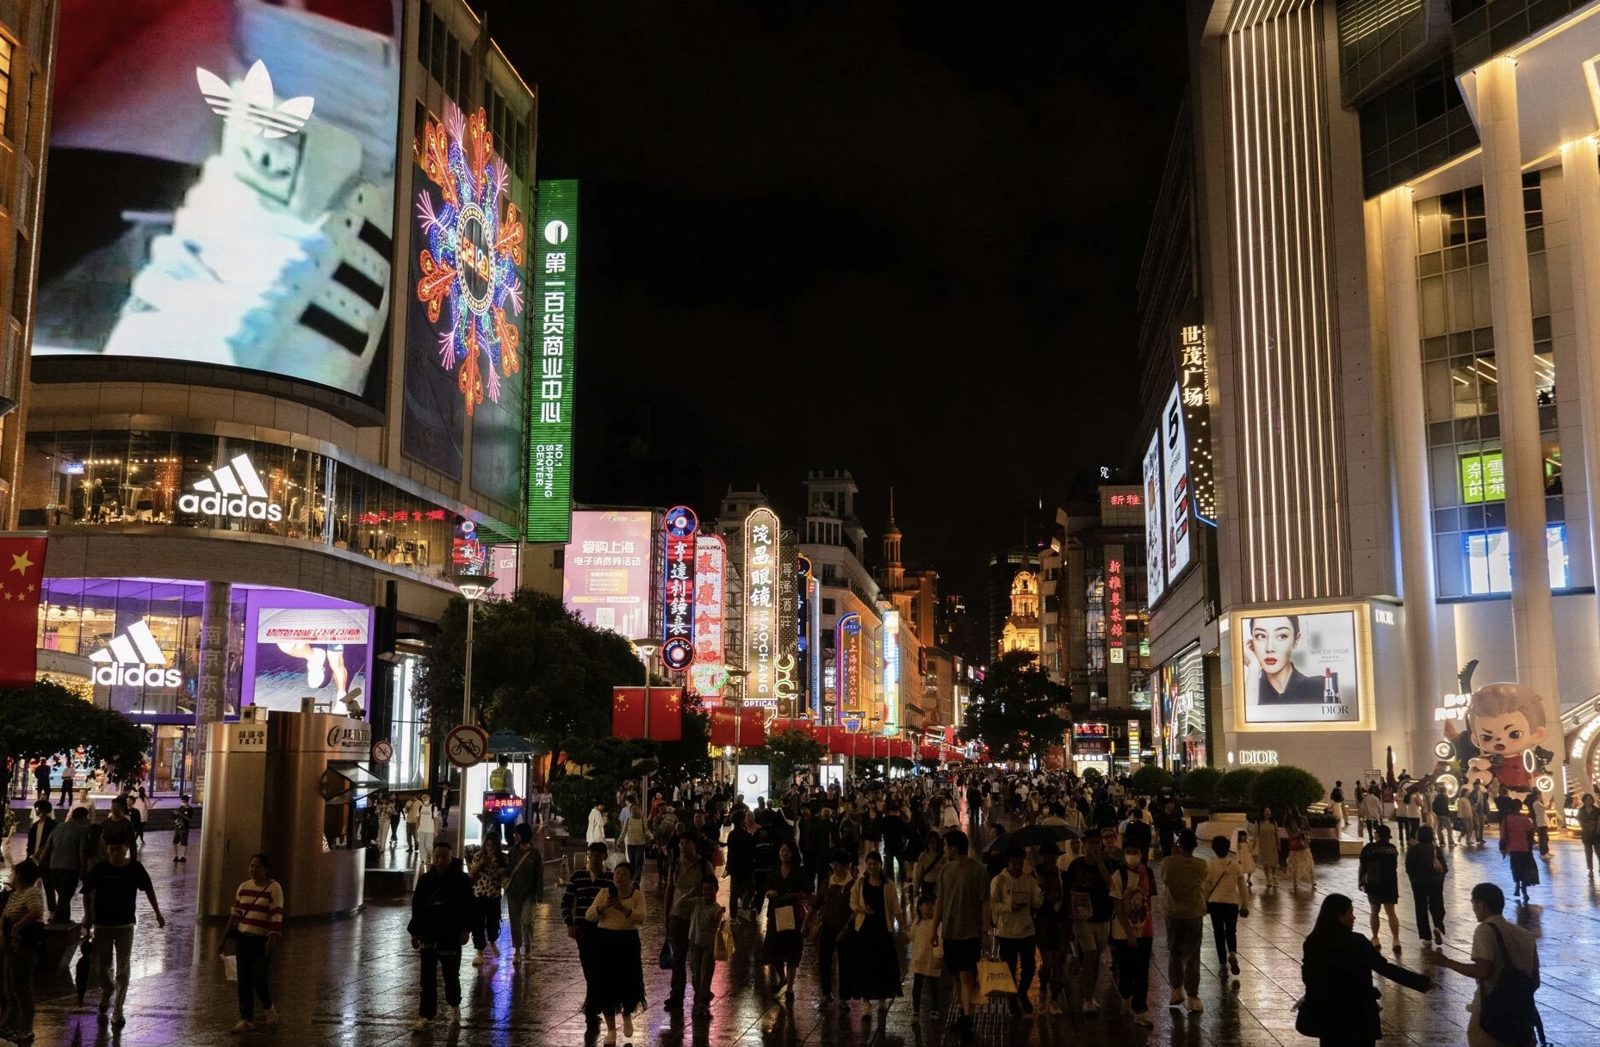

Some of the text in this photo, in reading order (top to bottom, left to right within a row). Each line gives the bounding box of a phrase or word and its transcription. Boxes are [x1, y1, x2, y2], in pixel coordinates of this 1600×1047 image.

[540, 252, 566, 422] 第一百货商业中心
[1180, 325, 1203, 406] 世茂广场
[535, 444, 545, 487] CENTER
[544, 444, 554, 498] SHOPPING
[555, 443, 563, 467] NO.1
[178, 491, 283, 522] adidas
[1110, 494, 1141, 506] 新雅
[582, 540, 634, 553] 爱购上海
[750, 524, 772, 607] 茂昌眼镜
[1109, 560, 1123, 637] 新雅粤菜馆
[1375, 609, 1394, 625] DIOR
[202, 626, 221, 718] 南京东路
[1322, 705, 1349, 714] DIOR
[1240, 750, 1279, 765] DIOR
